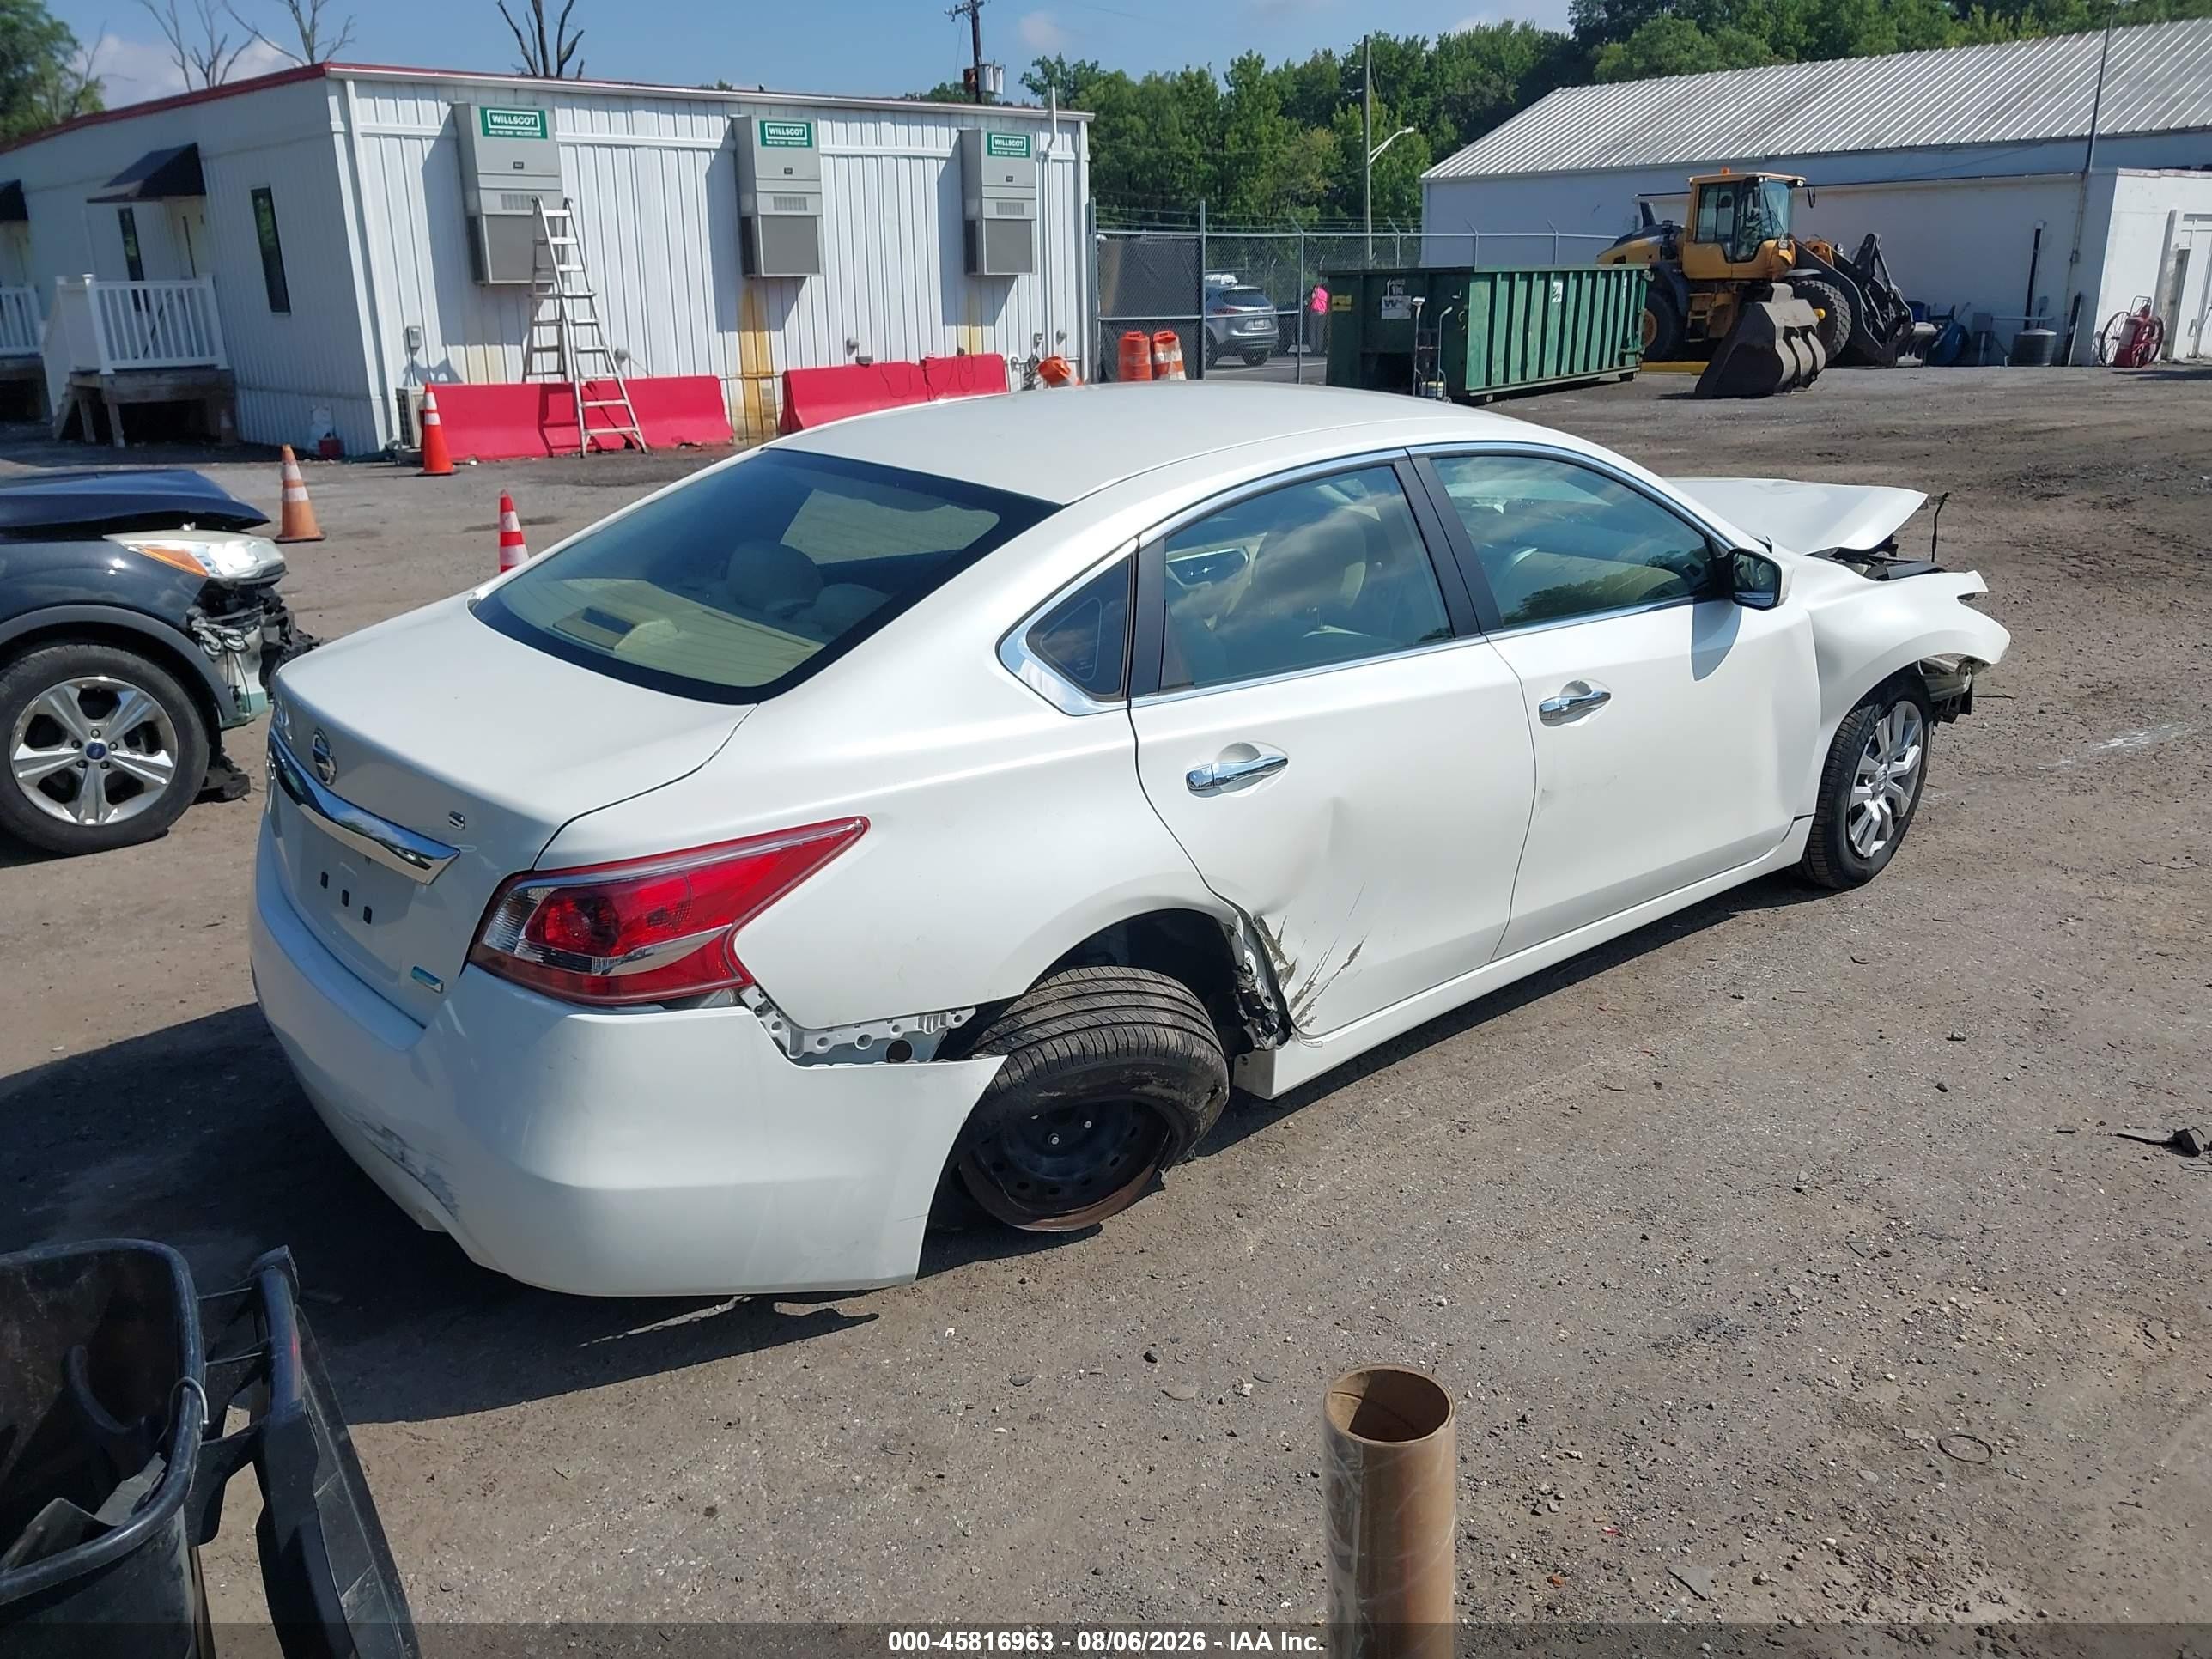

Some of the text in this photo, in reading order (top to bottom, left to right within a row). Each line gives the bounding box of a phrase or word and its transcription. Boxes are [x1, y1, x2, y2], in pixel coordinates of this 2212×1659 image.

[491, 114, 537, 125] WILLSCOT
[769, 126, 804, 137] WILLSCOT
[994, 138, 1023, 147] WILLSCOT
